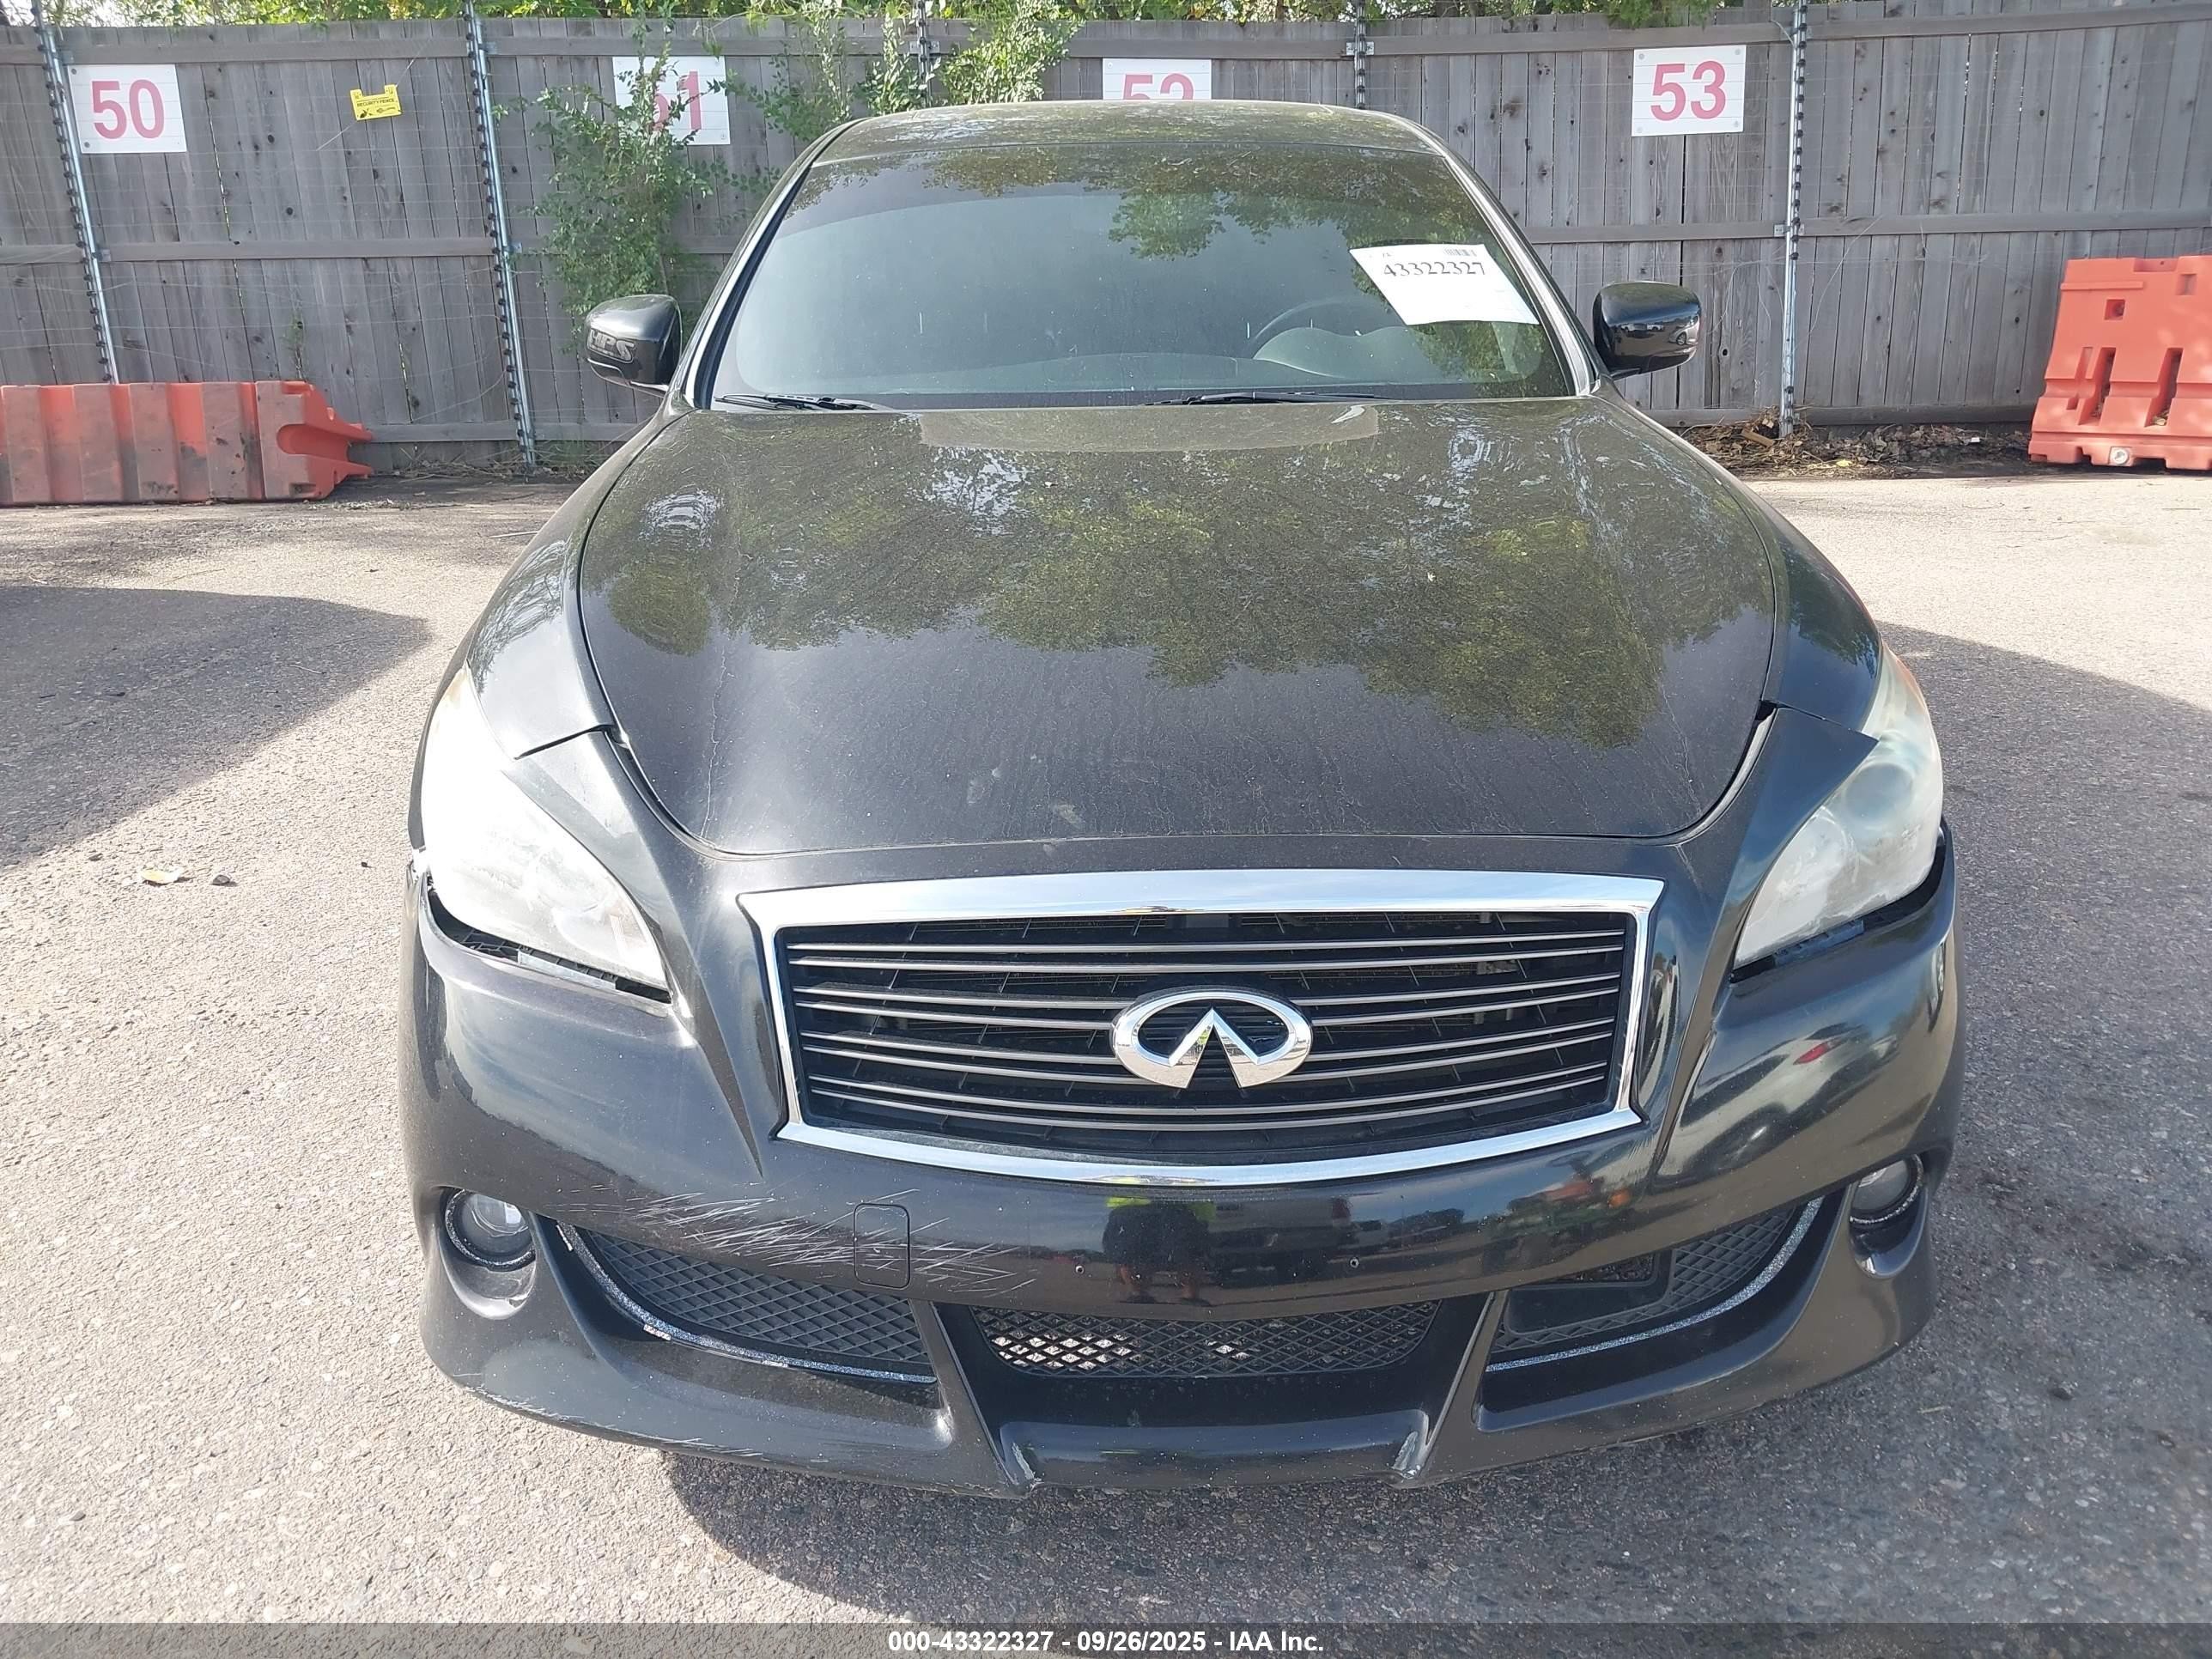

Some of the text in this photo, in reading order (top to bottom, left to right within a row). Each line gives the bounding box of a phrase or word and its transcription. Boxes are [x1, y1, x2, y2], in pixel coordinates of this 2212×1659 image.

[91, 79, 165, 139] 50
[1650, 60, 1726, 121] 53
[1383, 261, 1486, 276] 43322327
